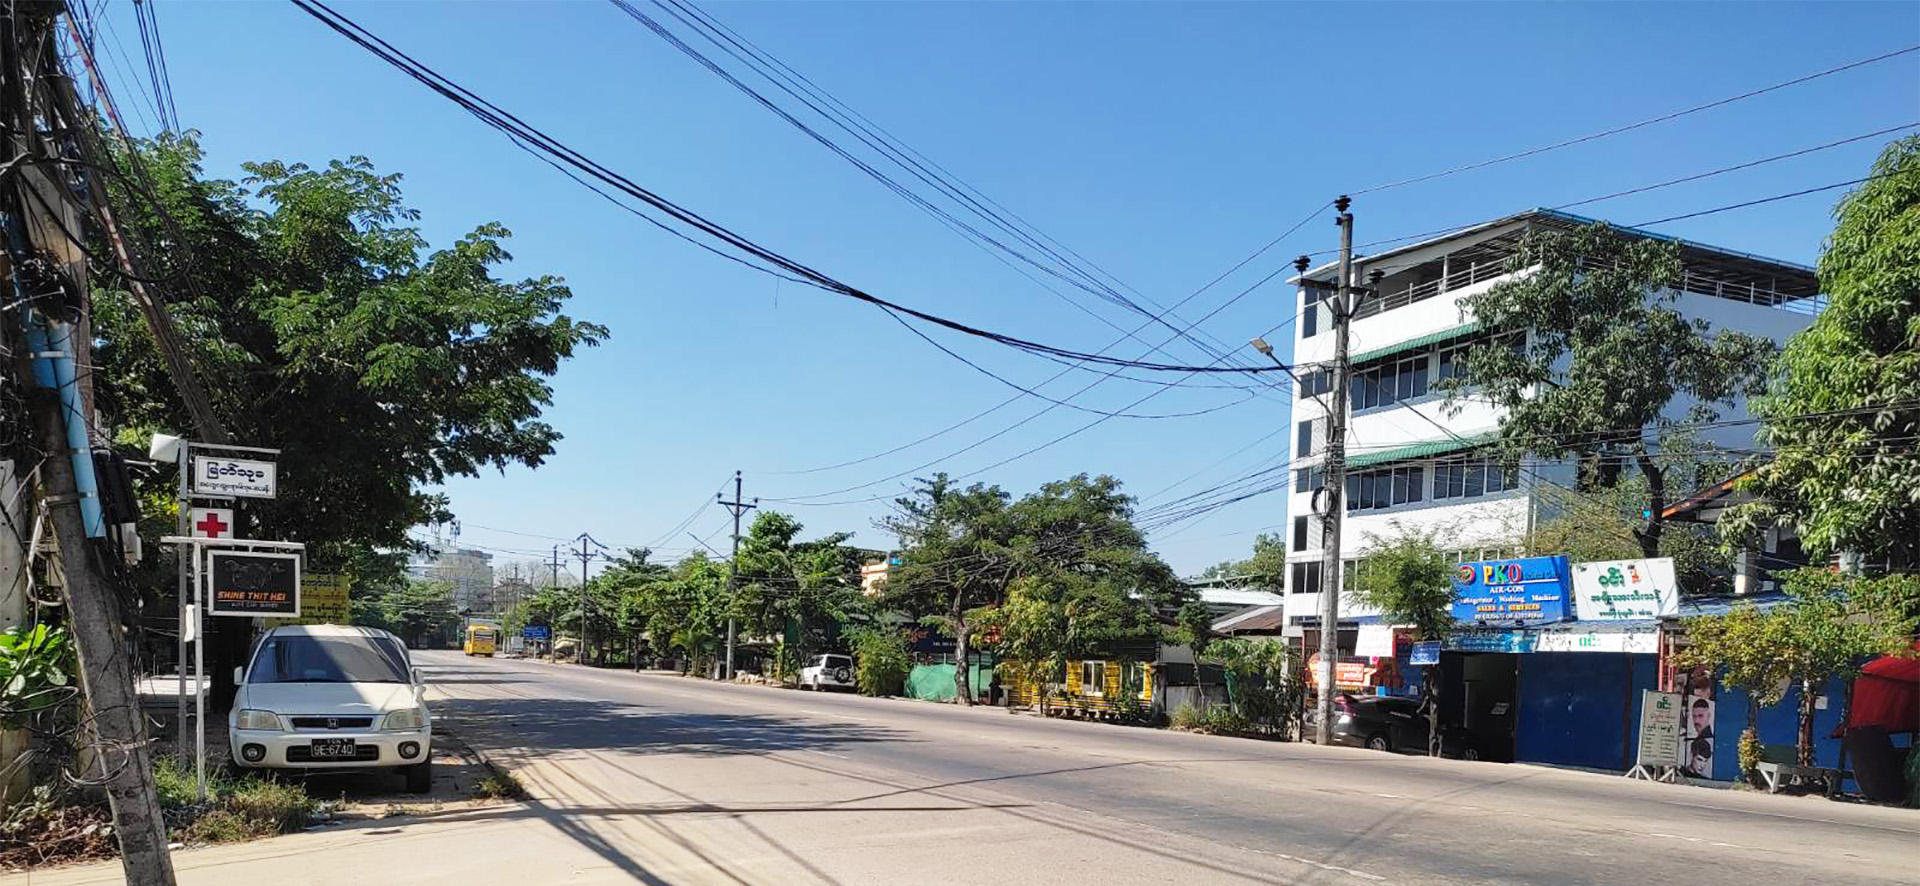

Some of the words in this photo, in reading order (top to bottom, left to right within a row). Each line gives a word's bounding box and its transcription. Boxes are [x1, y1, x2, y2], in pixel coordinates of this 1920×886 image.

[1482, 564, 1521, 584] PKO
[217, 591, 246, 600] SHINE
[248, 592, 269, 600] THIT
